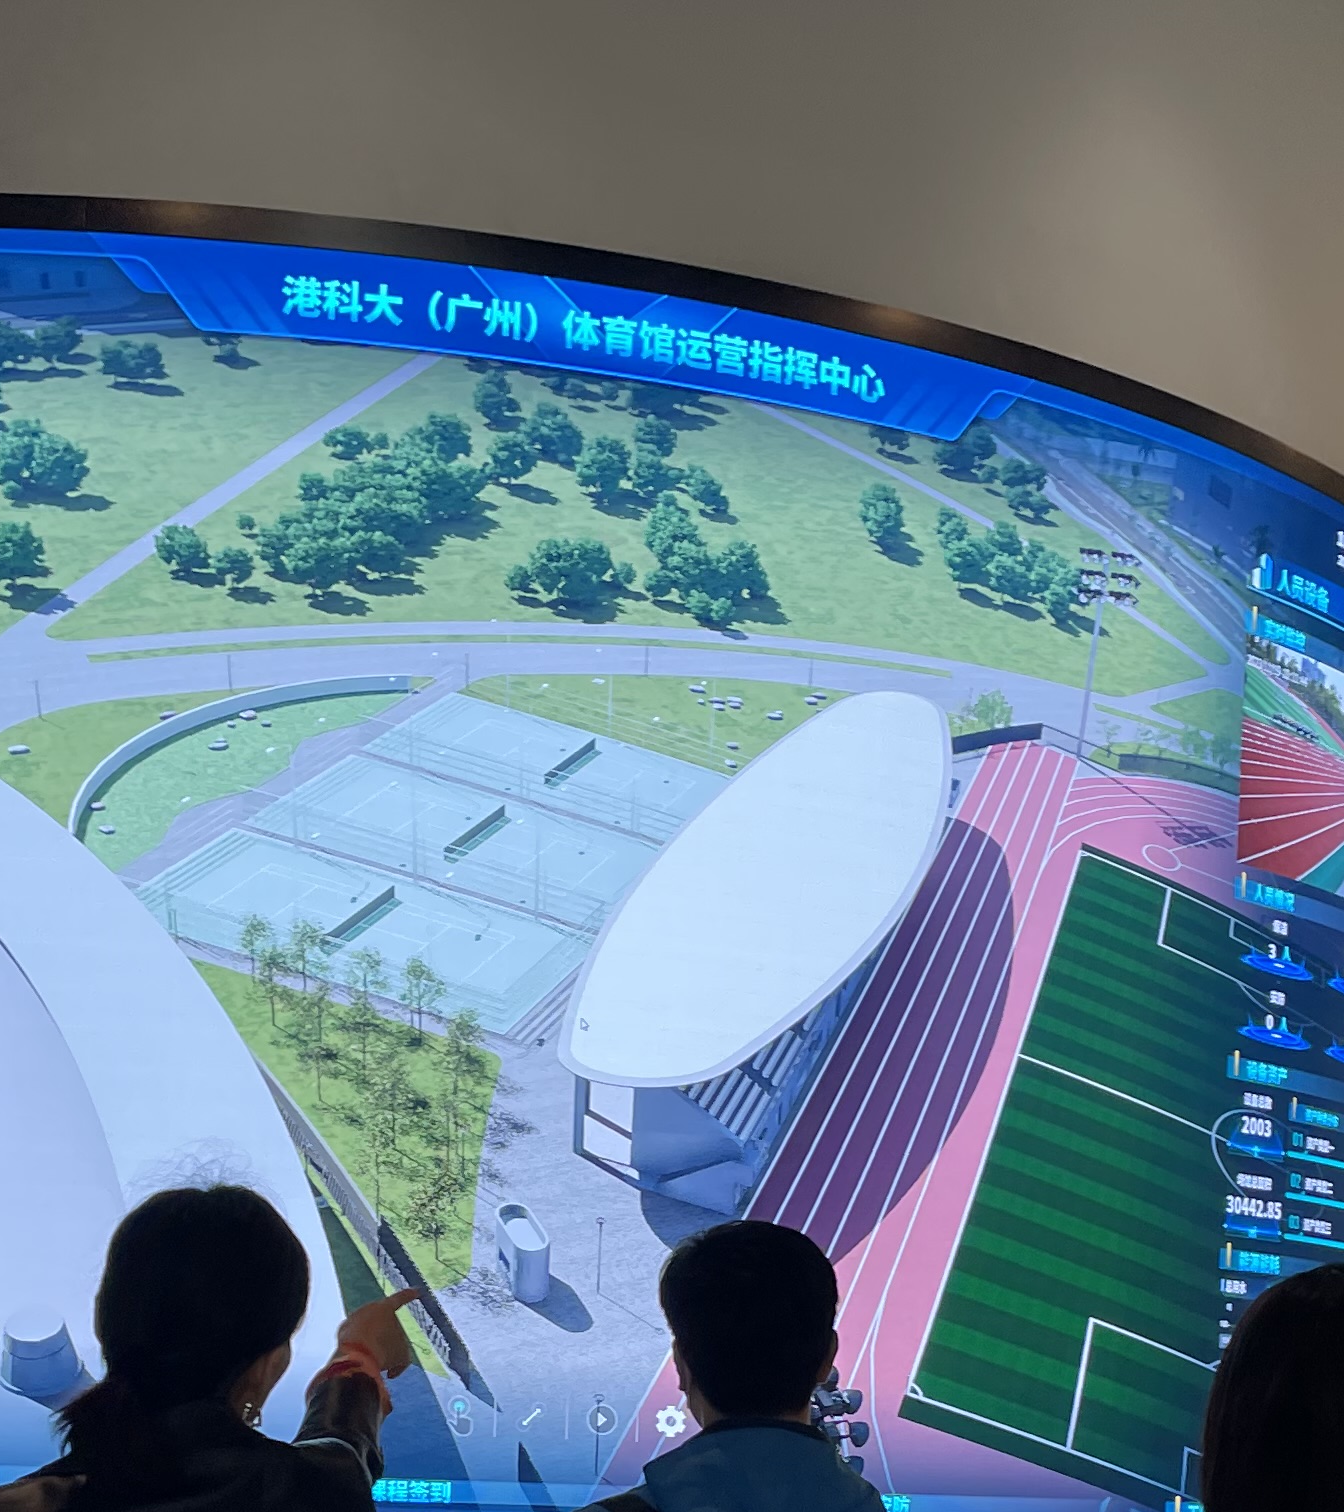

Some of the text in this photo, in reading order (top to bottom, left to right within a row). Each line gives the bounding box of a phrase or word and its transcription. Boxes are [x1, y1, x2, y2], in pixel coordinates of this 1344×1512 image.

[281, 274, 886, 404] 港科大（广州）体育馆运营指挥中心
[1276, 569, 1330, 614] 人员设备
[1268, 944, 1277, 959] 3
[1240, 1115, 1273, 1138] 2003
[1225, 1194, 1283, 1220] 30442.85
